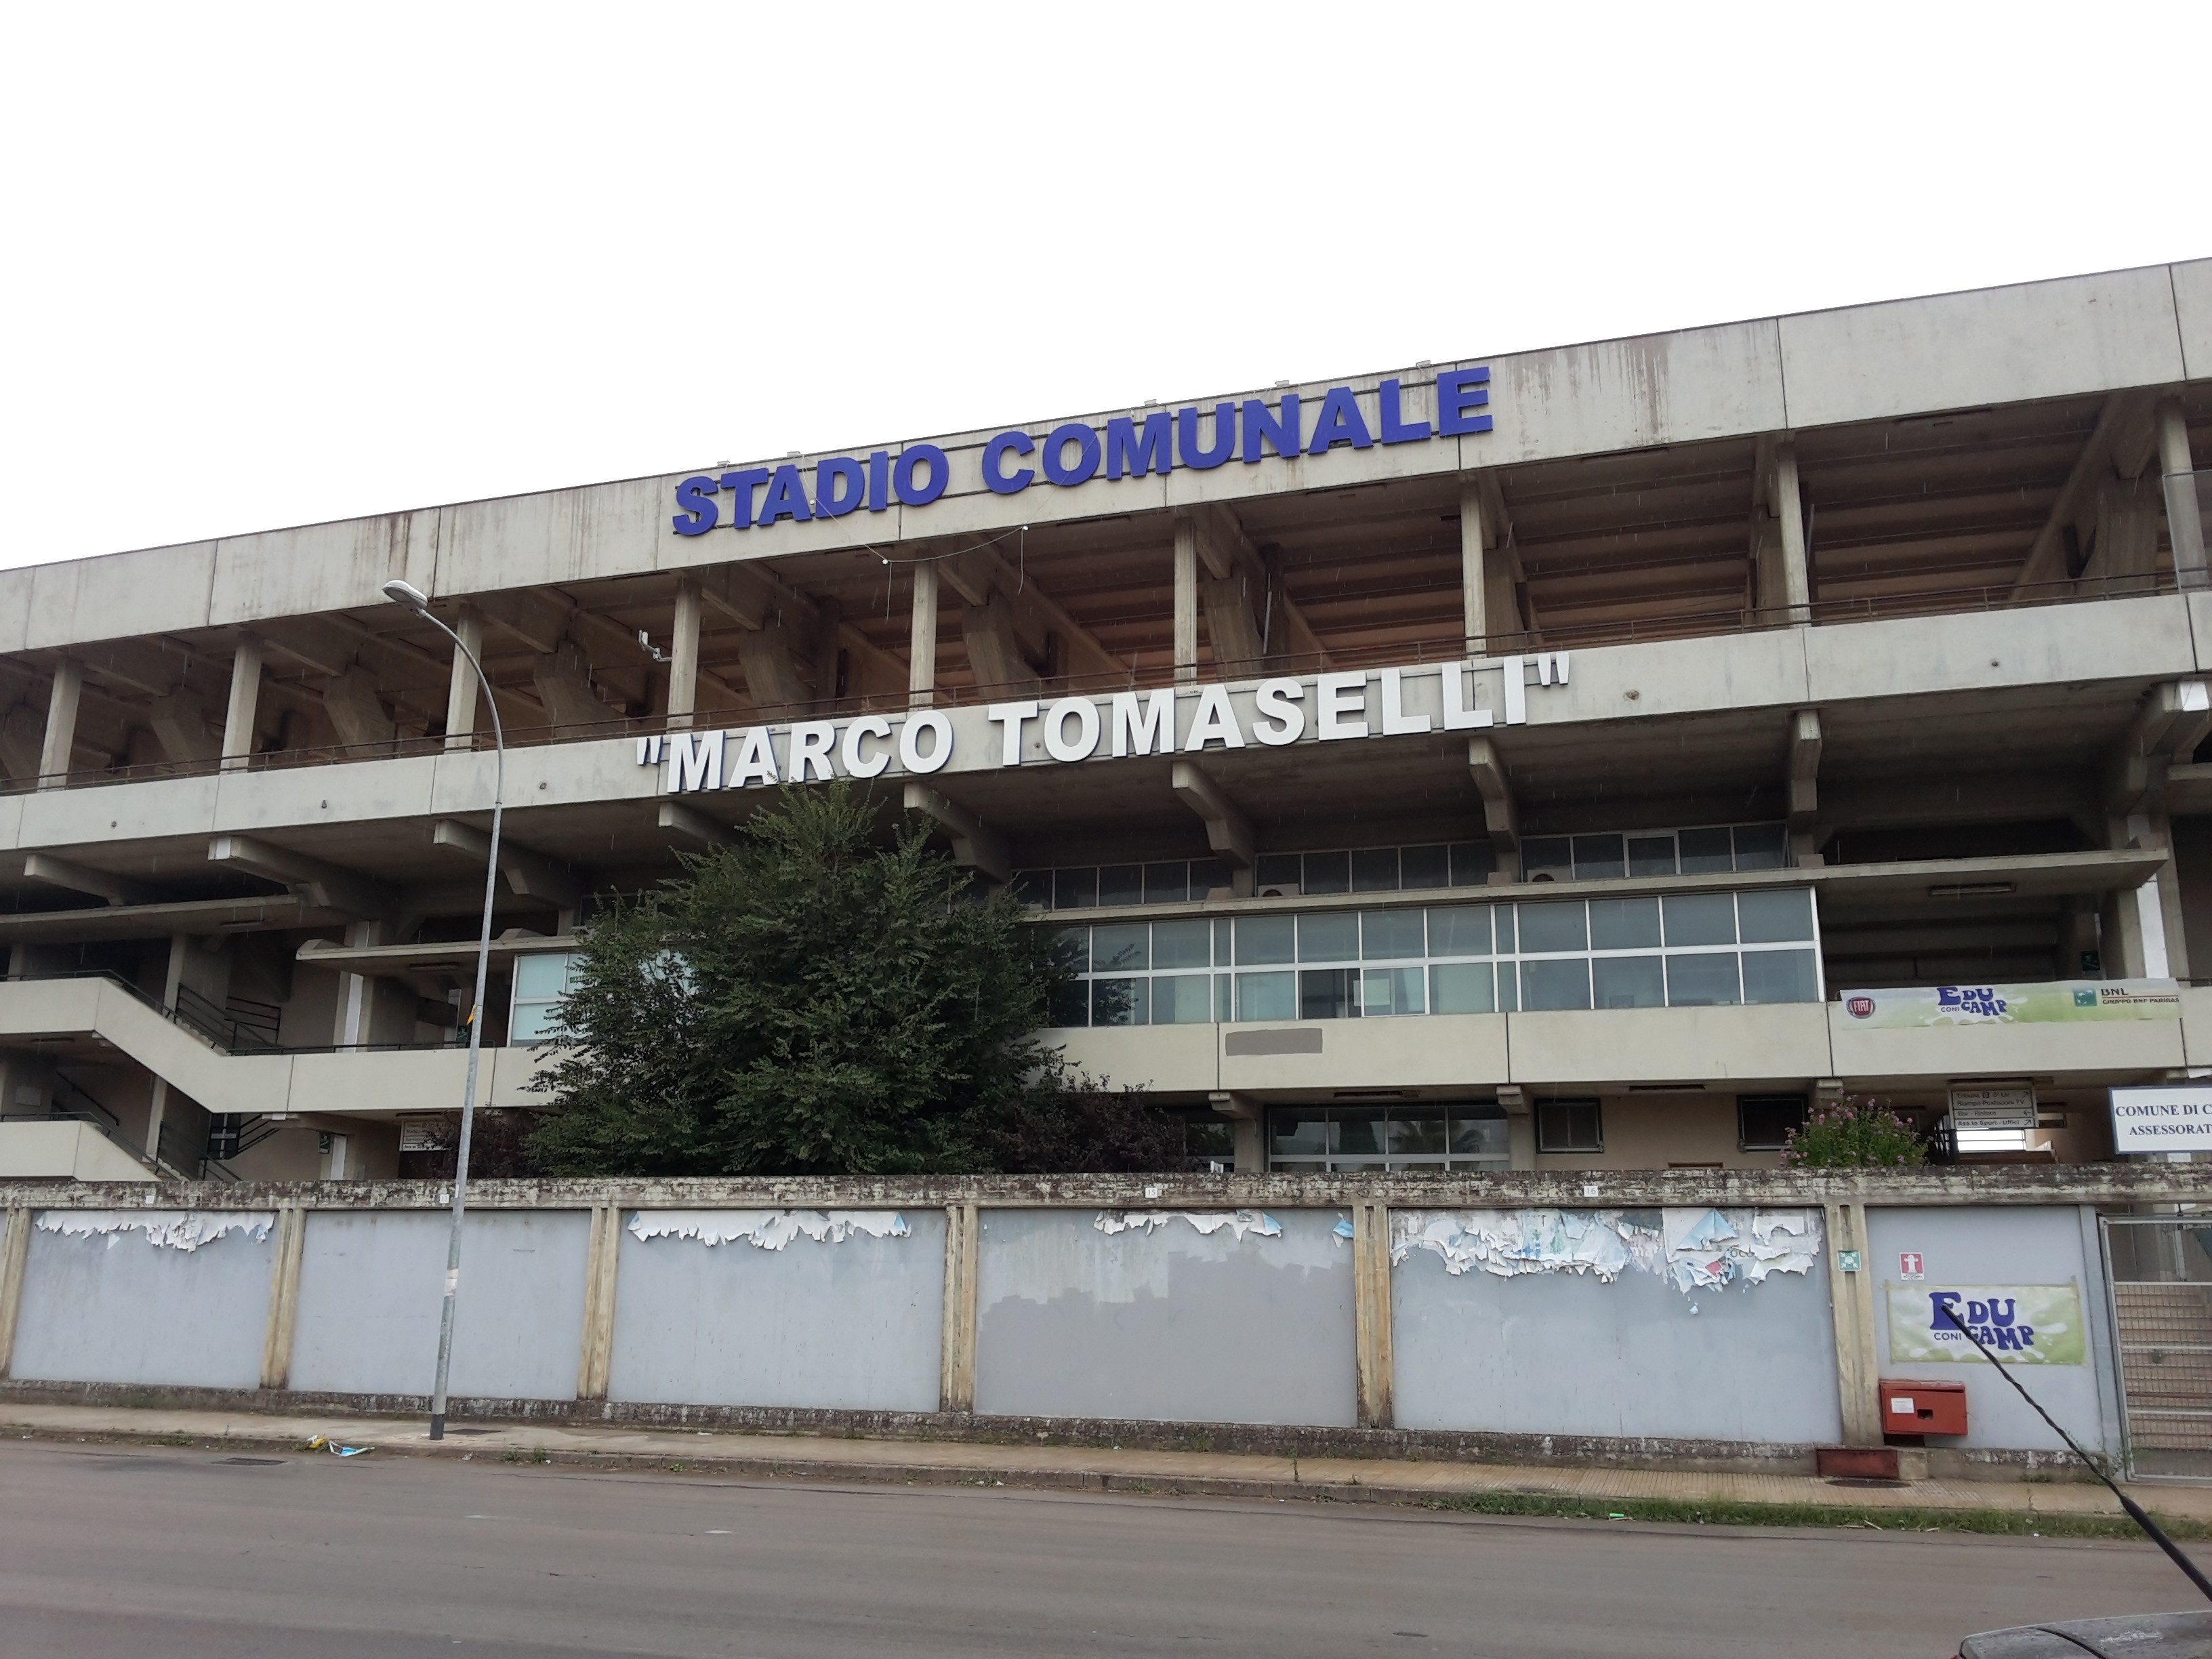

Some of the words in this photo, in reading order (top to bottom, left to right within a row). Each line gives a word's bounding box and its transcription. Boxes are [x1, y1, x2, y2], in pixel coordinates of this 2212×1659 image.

[672, 444, 949, 536] STADIO
[981, 367, 1493, 494] COMUNALE
[1936, 987, 1994, 1006] EDU
[2101, 988, 2129, 996] BNL
[1853, 1000, 1870, 1012] FIAT
[1961, 1000, 2007, 1017] CAMP
[2115, 1105, 2179, 1117] COMUNE
[2184, 1104, 2199, 1115] DI
[1929, 1292, 2016, 1331] EDU
[1933, 1332, 1963, 1340] CONI
[1966, 1326, 2034, 1351] CAMP
